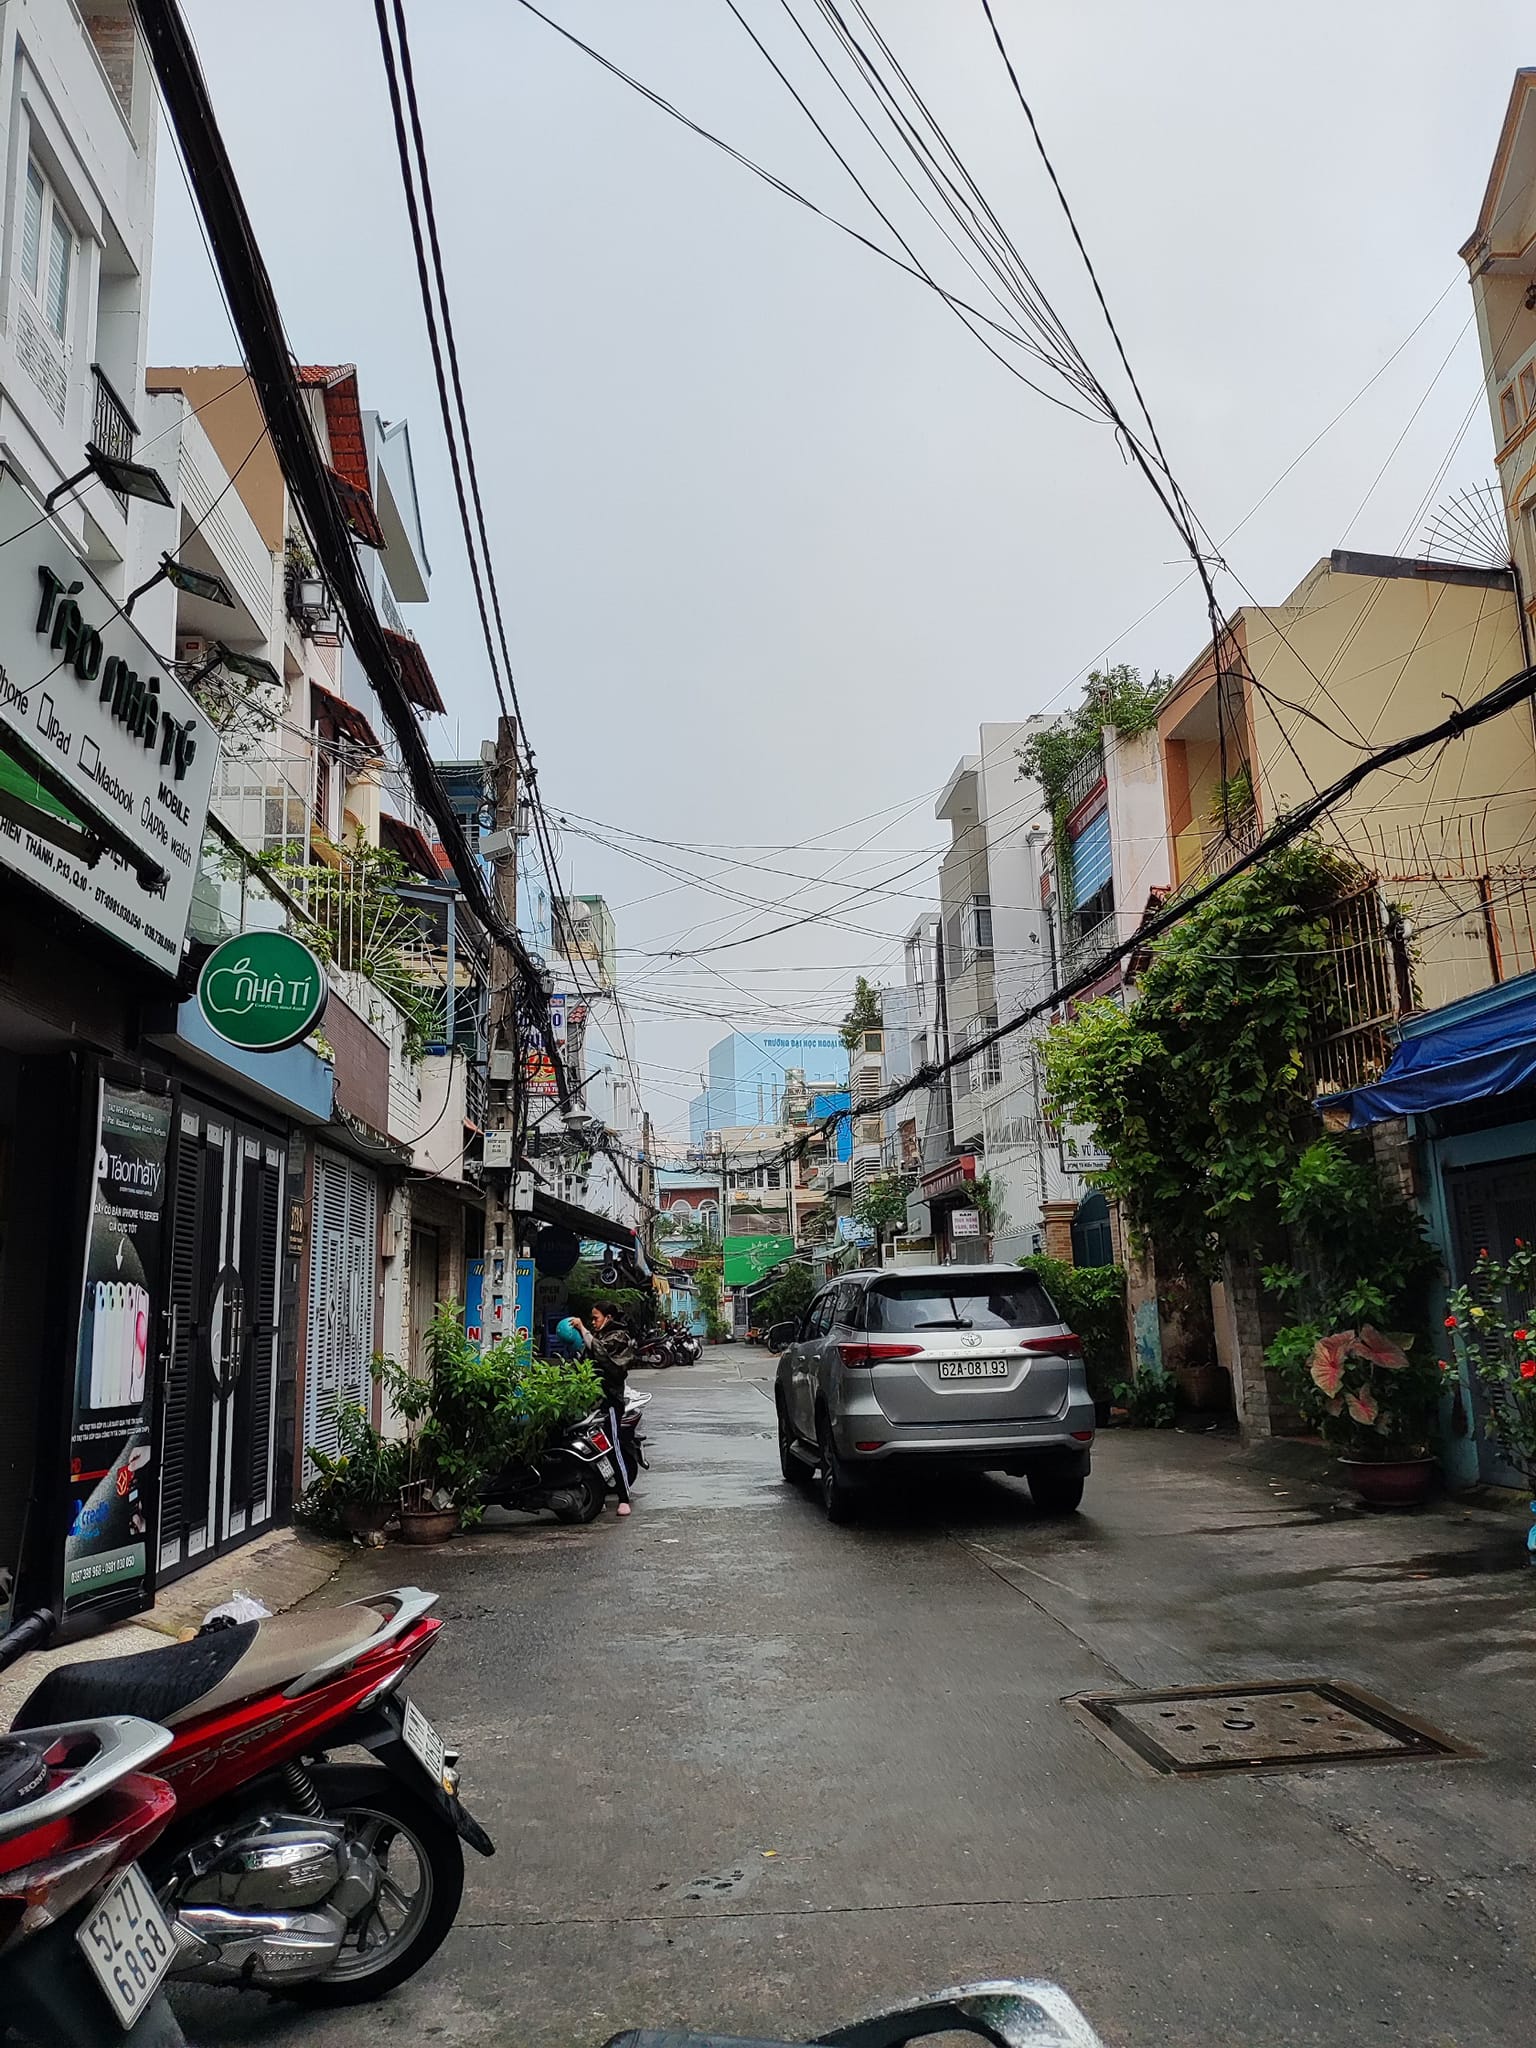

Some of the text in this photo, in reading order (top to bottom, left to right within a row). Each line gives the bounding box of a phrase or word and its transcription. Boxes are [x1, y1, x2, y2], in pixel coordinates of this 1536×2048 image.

[96, 761, 135, 815] Macbook
[171, 837, 192, 867] watch
[157, 781, 190, 826] MOBILE
[288, 976, 312, 1006] TÍ
[763, 1038, 789, 1047] TRƯỜNG
[791, 1039, 802, 1048] ĐẠI
[803, 1039, 817, 1049] HỌC
[941, 1360, 1006, 1377] 62A-081.93
[89, 1875, 143, 1963] 52-Z7
[113, 1918, 167, 2007] 6868
